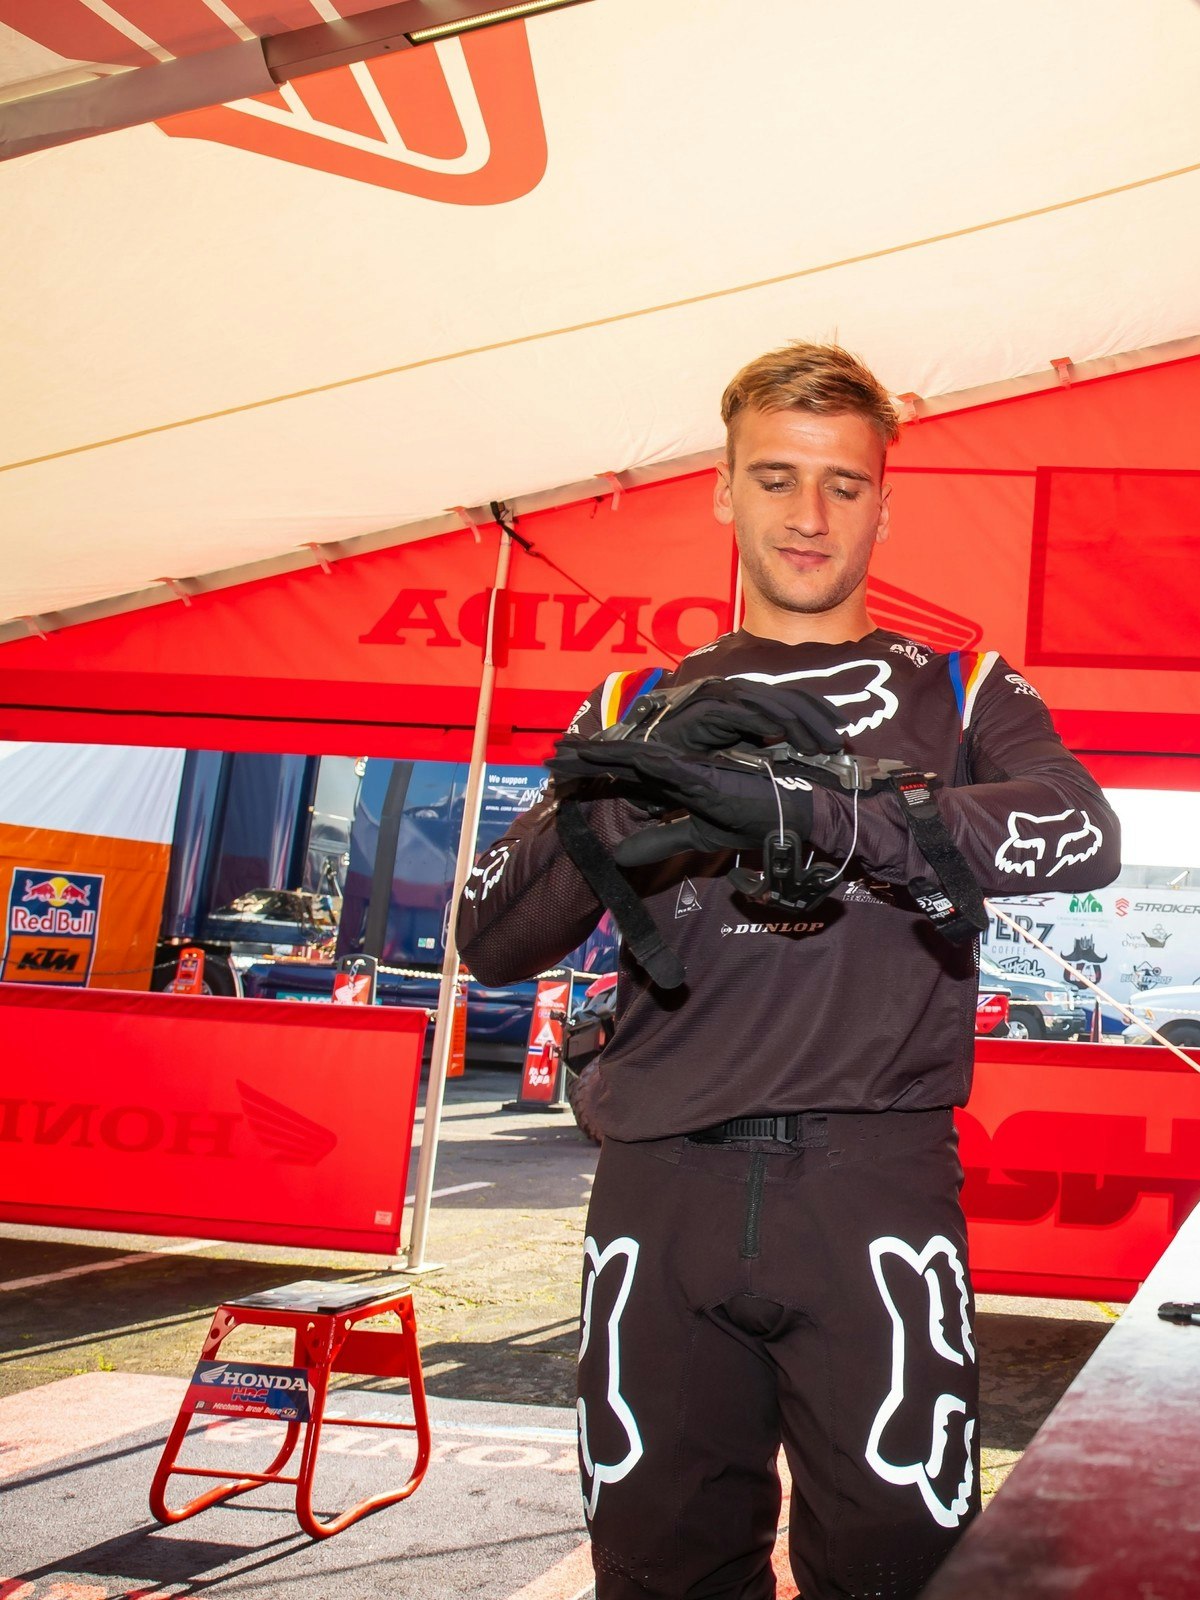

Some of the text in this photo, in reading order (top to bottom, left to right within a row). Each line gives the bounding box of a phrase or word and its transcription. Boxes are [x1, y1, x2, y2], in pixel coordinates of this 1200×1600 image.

[488, 774, 528, 786] We support
[12, 906, 96, 935] Red Bull
[733, 922, 825, 935] DUNLOP
[991, 945, 1027, 955] COFFEE
[17, 947, 80, 972] KTM
[220, 1371, 309, 1391] HONDA
[230, 1386, 269, 1404] HRC
